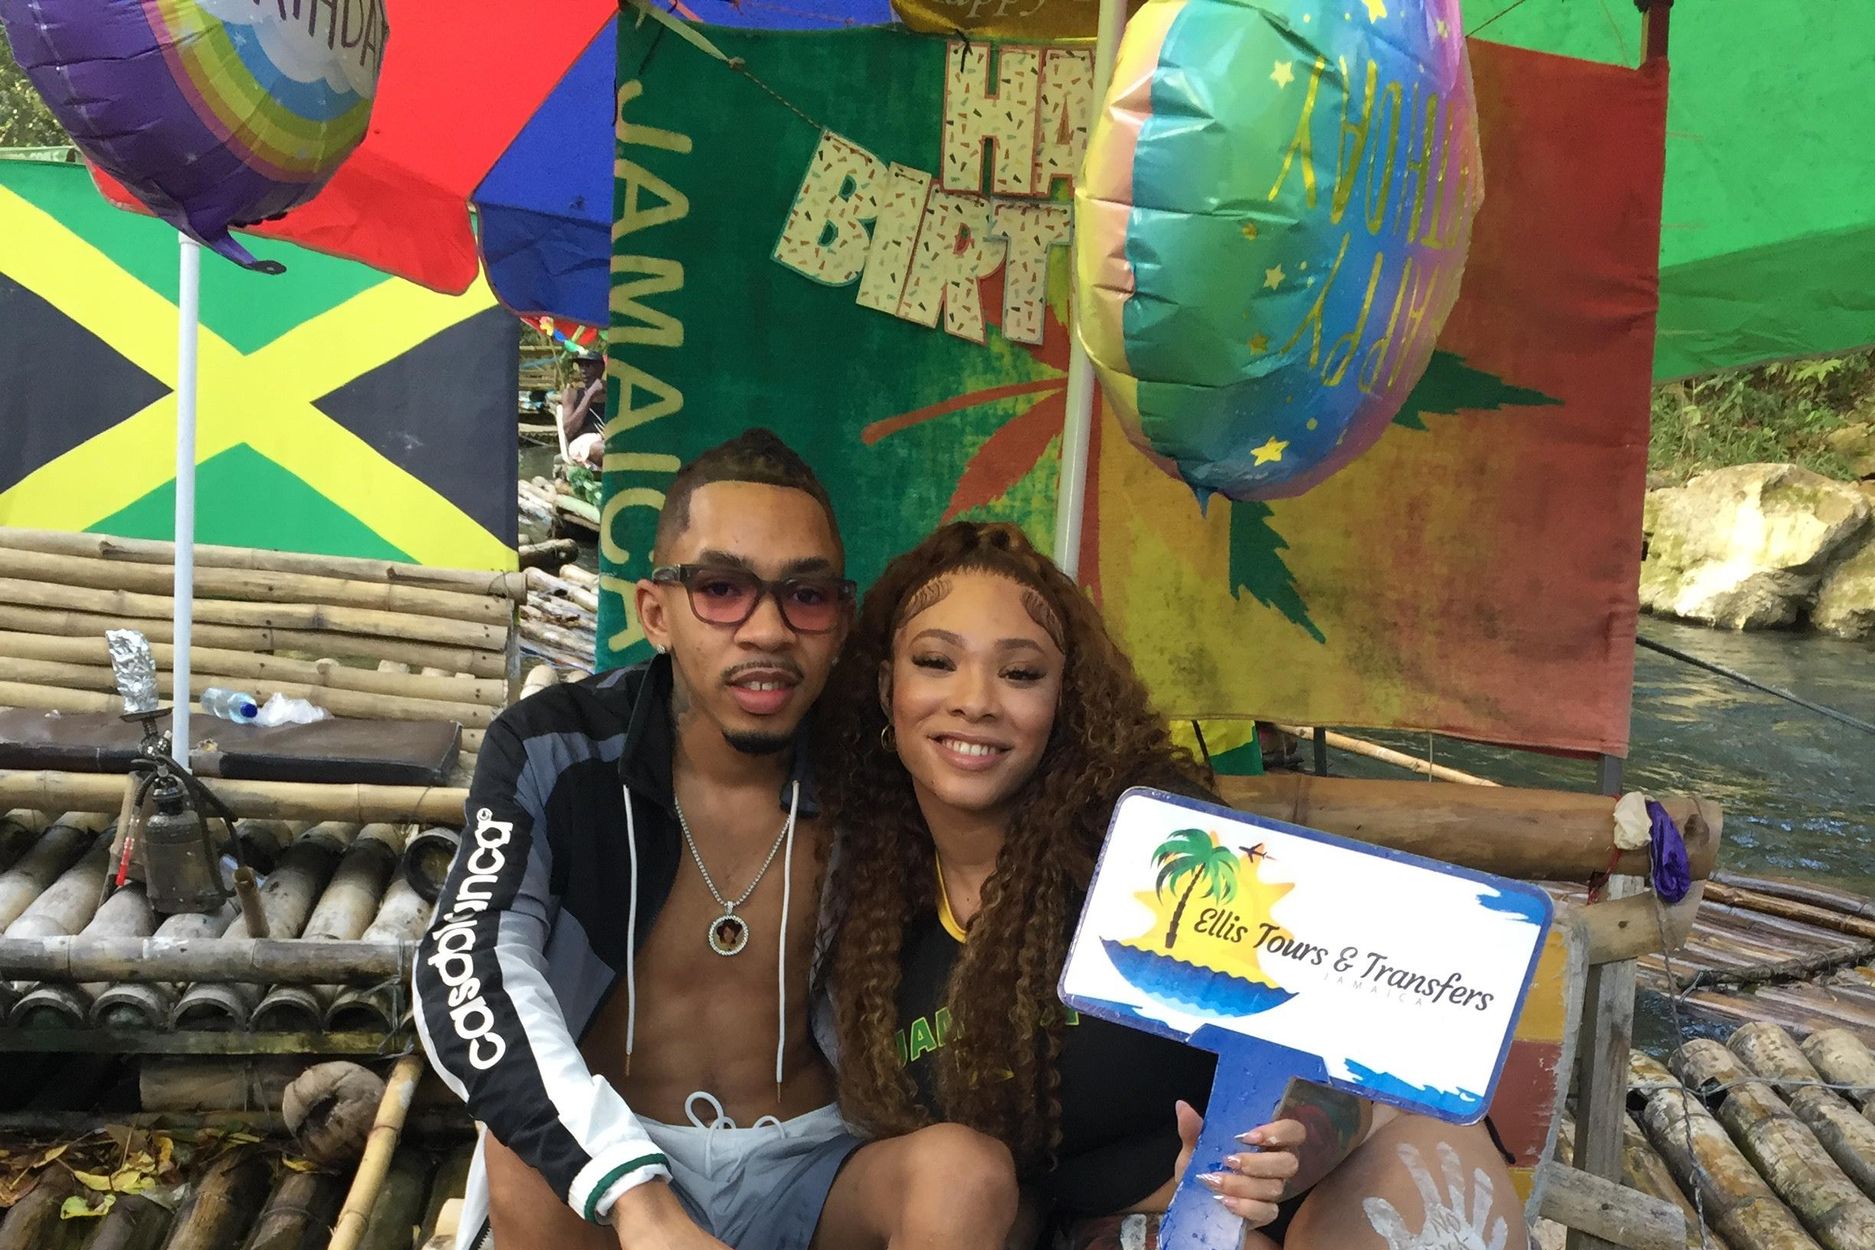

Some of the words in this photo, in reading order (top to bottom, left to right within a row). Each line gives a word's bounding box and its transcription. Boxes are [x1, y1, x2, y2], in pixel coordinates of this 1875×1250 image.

[940, 40, 1097, 198] HA
[770, 127, 1073, 346] BIRT
[1280, 233, 1440, 393] APPY
[600, 80, 693, 652] JAMAICA
[1193, 907, 1249, 944] Ellis
[1253, 922, 1329, 966] Tours
[1333, 946, 1359, 973] &
[1360, 952, 1495, 1012] Transfers
[1323, 973, 1423, 1006] JAMAICA
